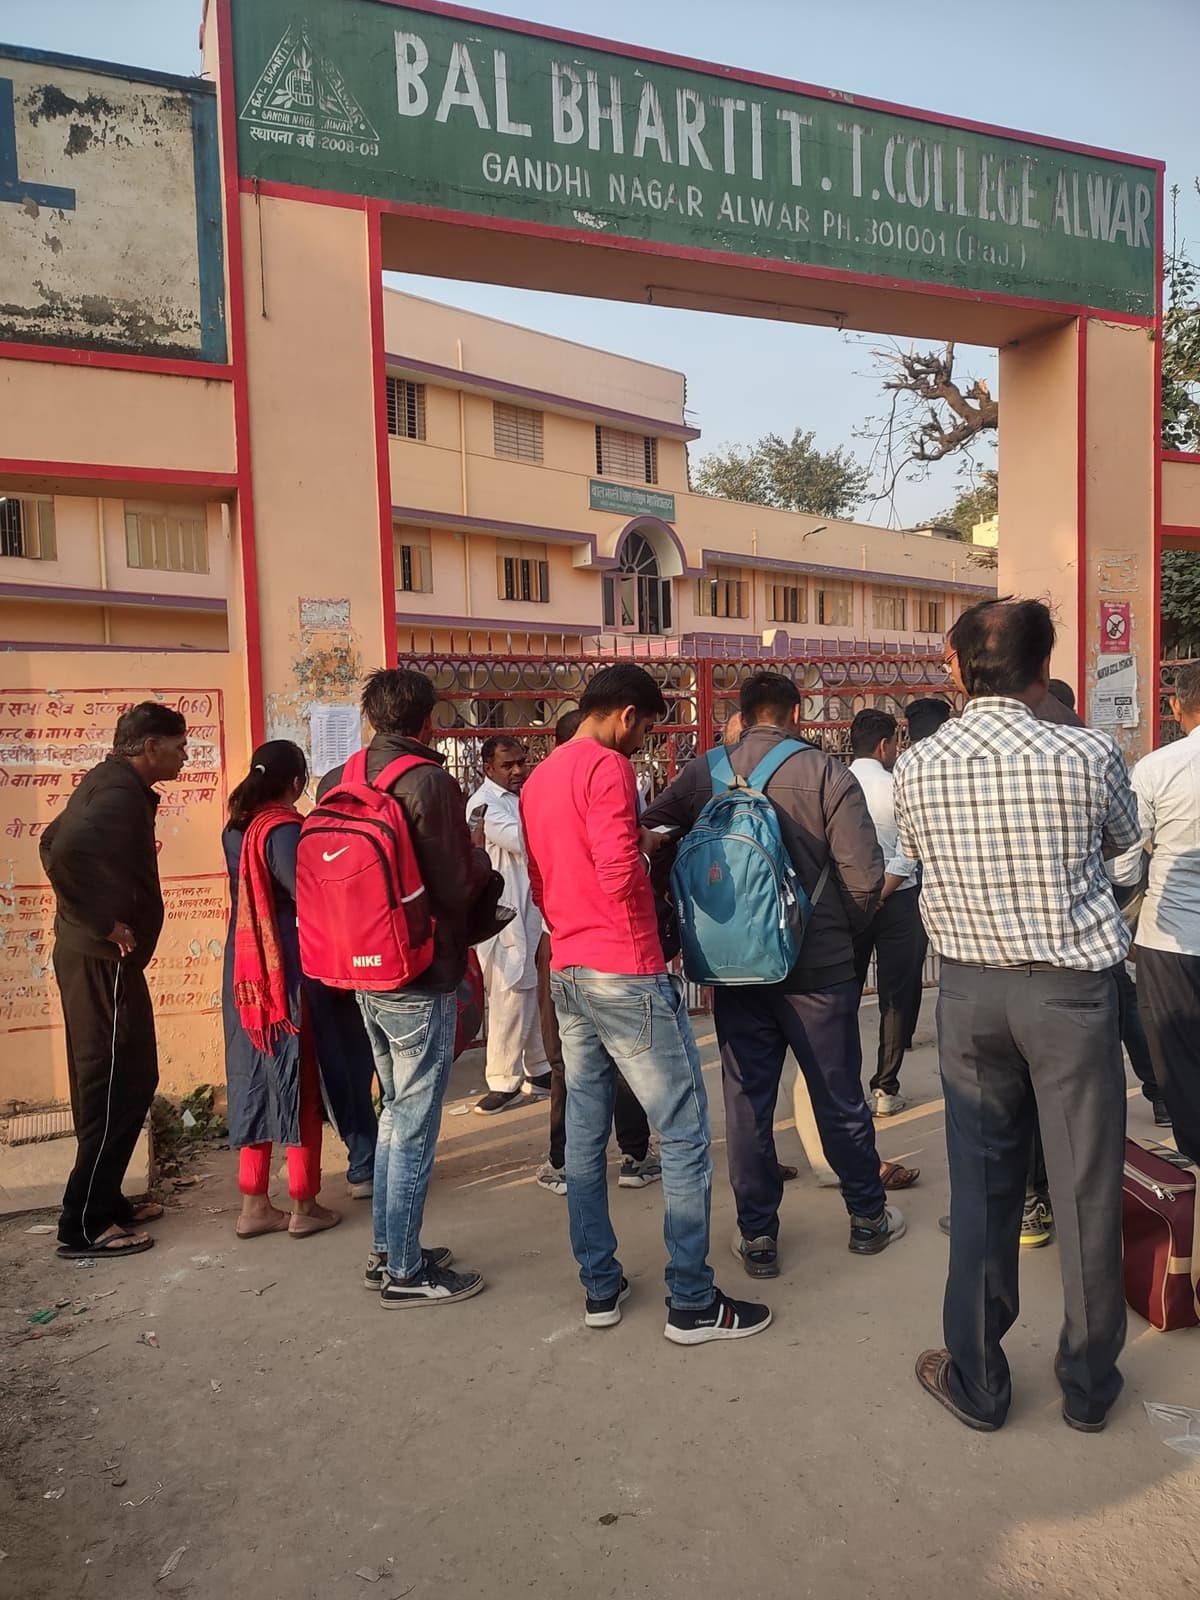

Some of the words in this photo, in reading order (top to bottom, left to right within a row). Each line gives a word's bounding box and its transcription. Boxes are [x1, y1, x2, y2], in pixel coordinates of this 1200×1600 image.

[393, 30, 532, 138] BAL
[550, 60, 764, 182] BHARTI
[261, 110, 290, 124] GANDHI
[250, 126, 294, 145] स्थापना
[482, 152, 590, 199] GANDHI
[609, 174, 704, 218] NAGAR
[718, 191, 810, 233] ALWAR
[352, 955, 382, 967] NIKE
